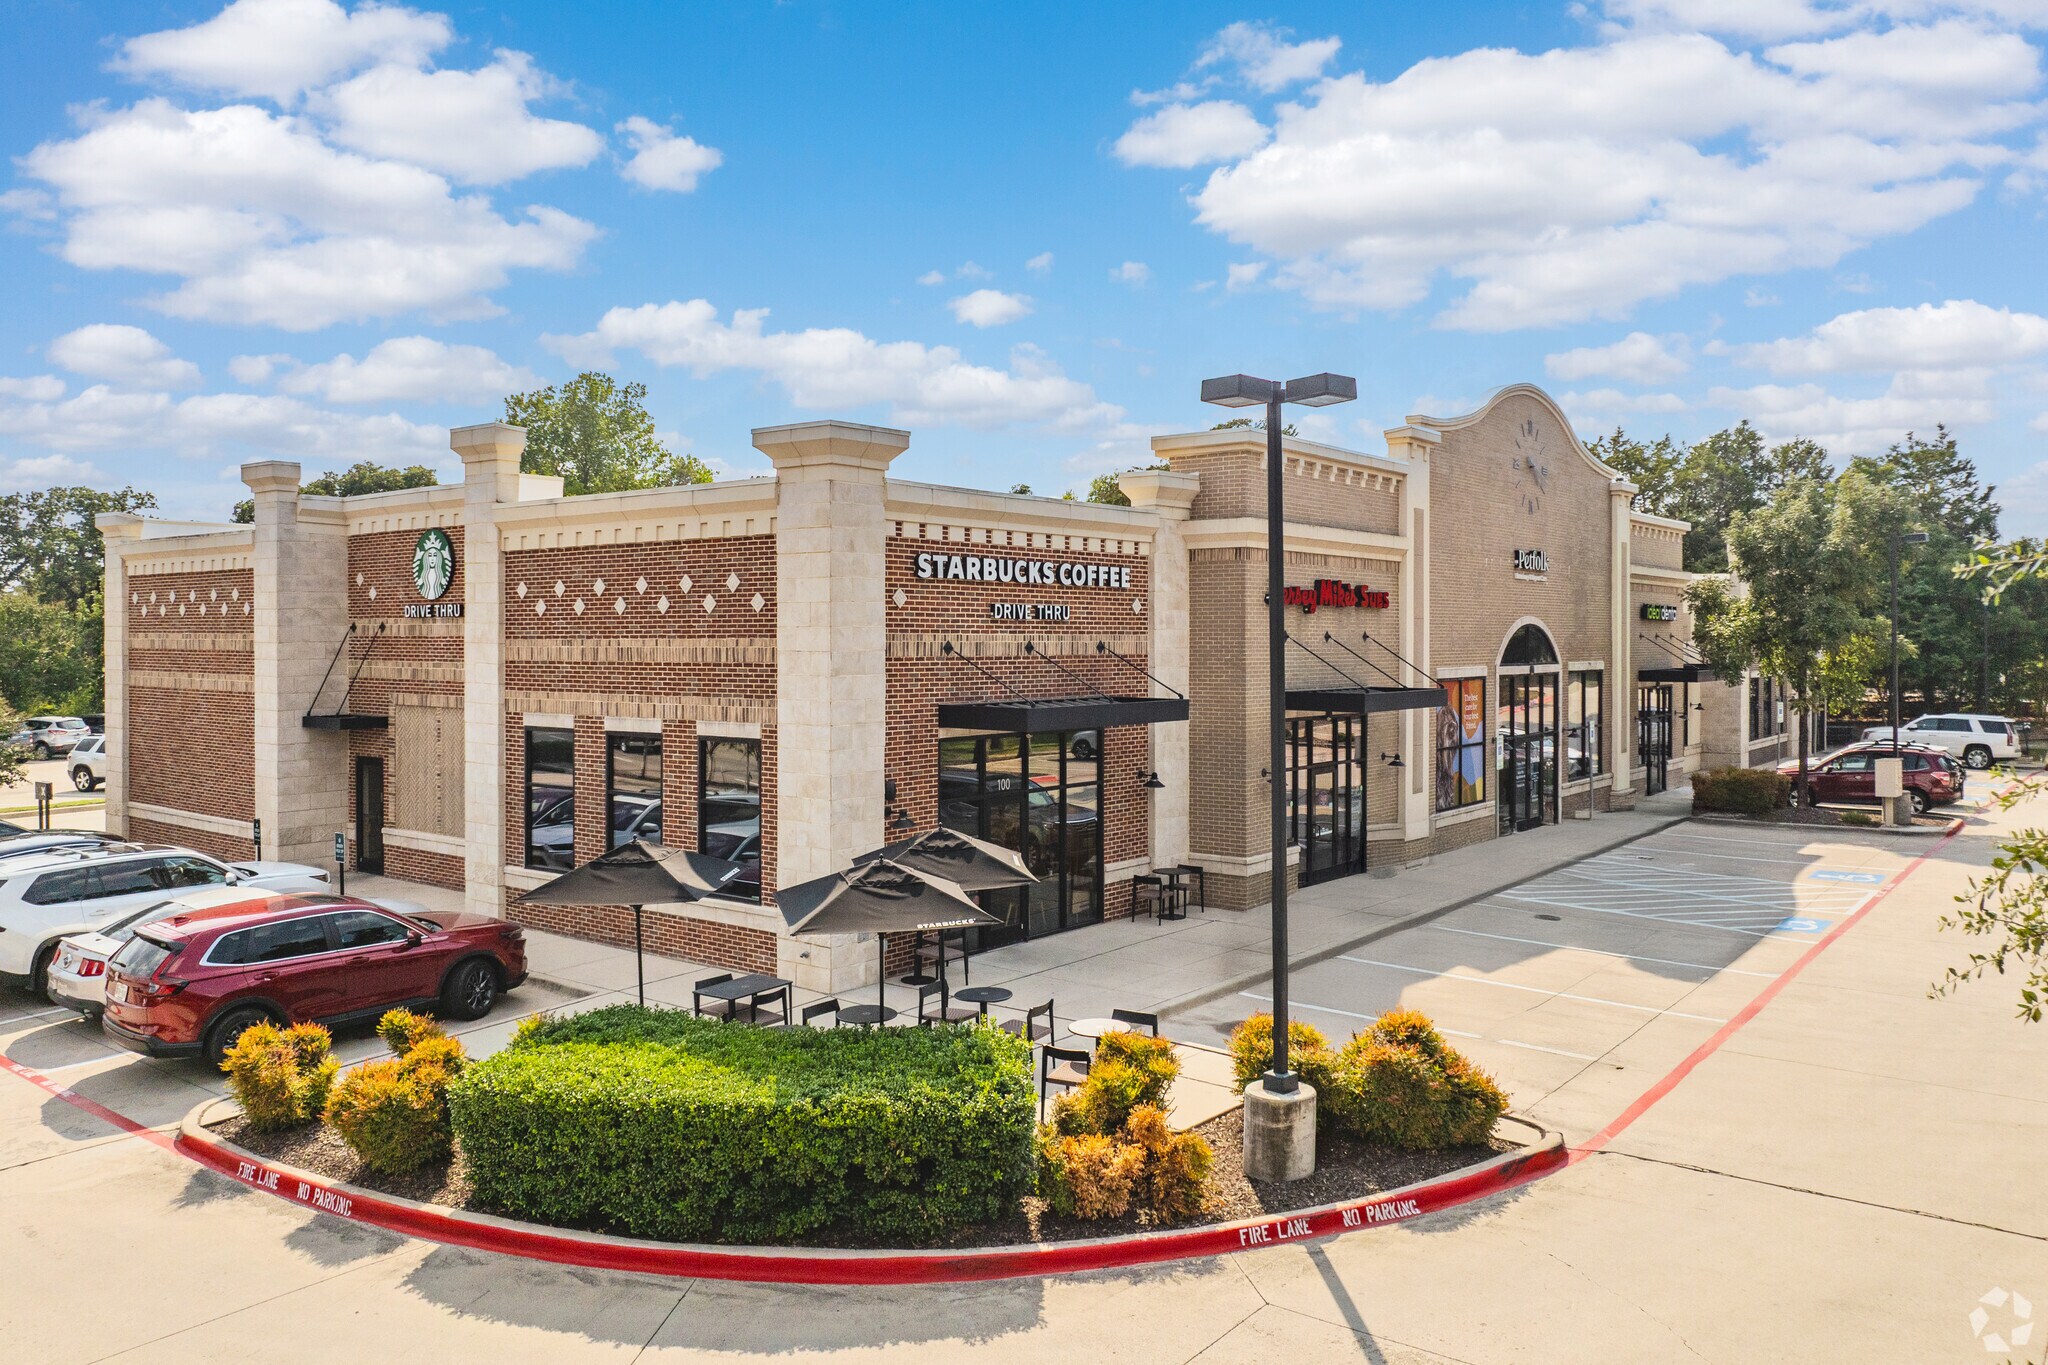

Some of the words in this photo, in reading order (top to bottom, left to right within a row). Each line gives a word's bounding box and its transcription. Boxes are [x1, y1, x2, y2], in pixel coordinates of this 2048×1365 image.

[916, 553, 1055, 585] STARBUCKS
[1058, 563, 1132, 589] COFFEE
[1518, 550, 1550, 571] Petfolk
[404, 604, 431, 618] DRIVE
[434, 603, 461, 617] THRU
[1265, 586, 1317, 614] ersey
[994, 603, 1033, 620] DRIVE
[1037, 604, 1071, 621] THRU
[997, 778, 1011, 791] 100
[916, 918, 976, 930] STARBUCKS
[237, 1162, 255, 1181] FIRE
[256, 1167, 280, 1190] LANE
[296, 1181, 310, 1200] NO
[312, 1187, 353, 1217] PARKING
[1239, 1224, 1272, 1247] FIRE
[1276, 1217, 1313, 1239] LANE
[1341, 1208, 1361, 1228] NO
[1366, 1199, 1421, 1224] PARKING
